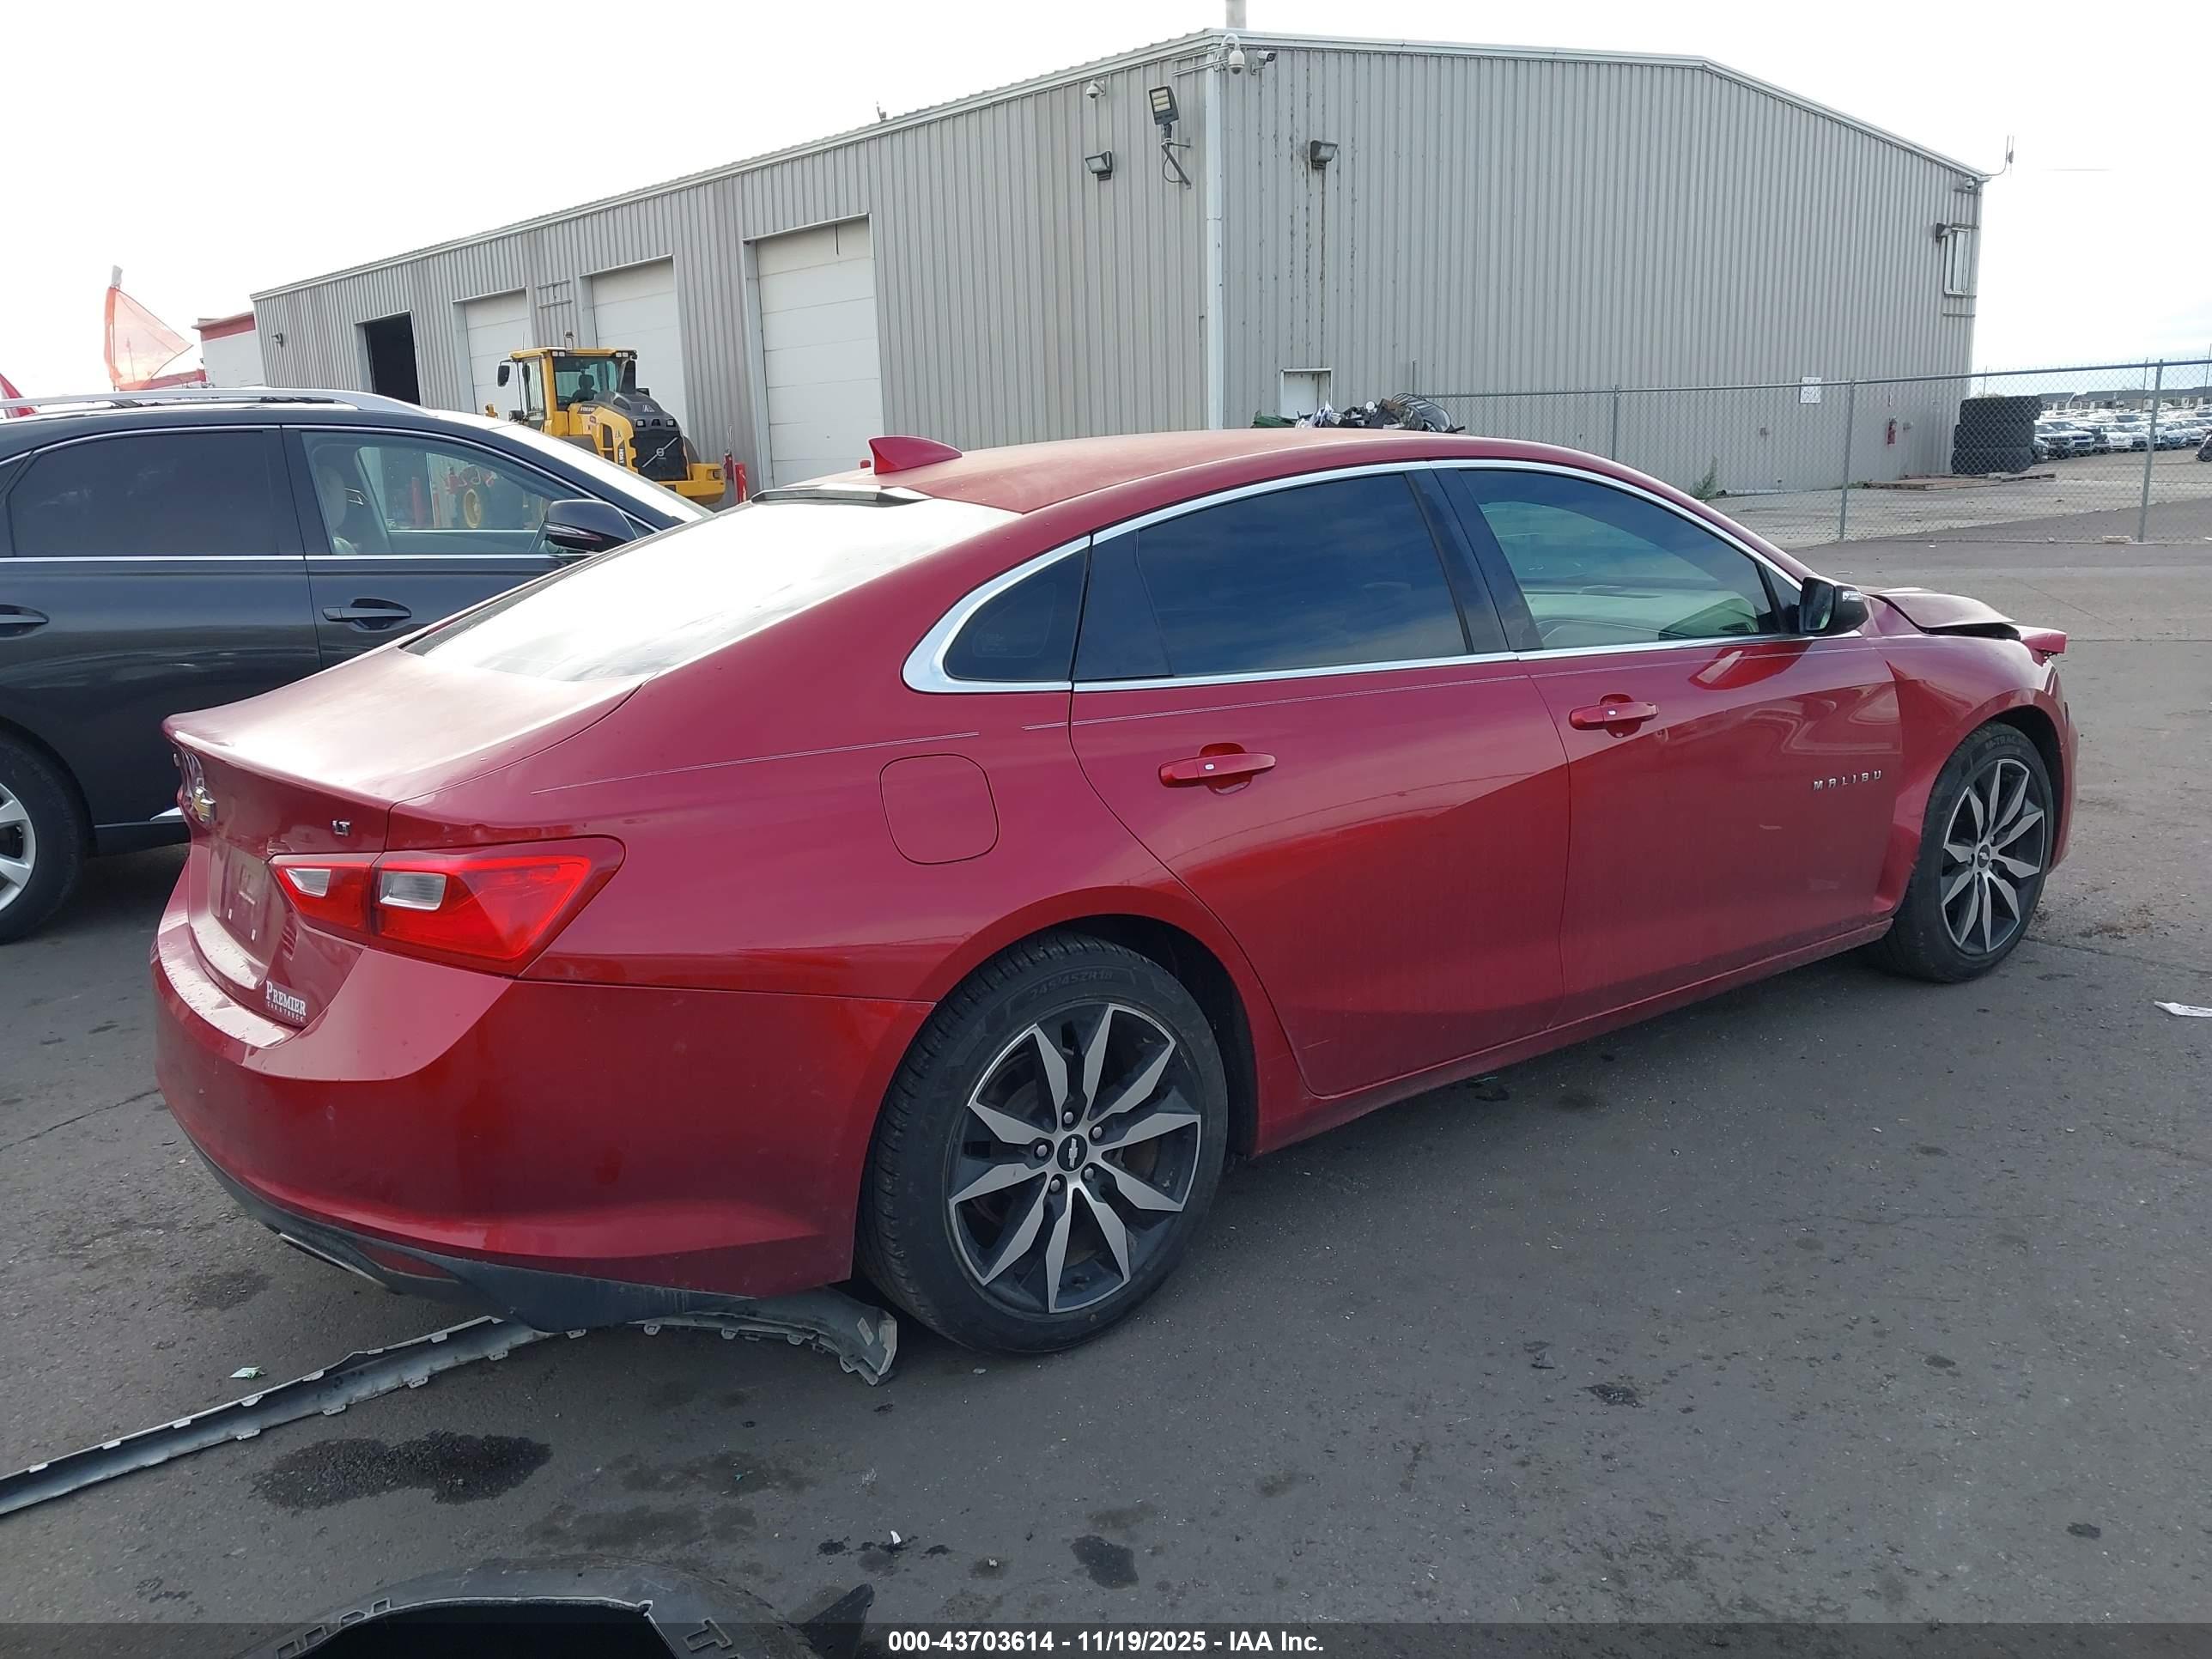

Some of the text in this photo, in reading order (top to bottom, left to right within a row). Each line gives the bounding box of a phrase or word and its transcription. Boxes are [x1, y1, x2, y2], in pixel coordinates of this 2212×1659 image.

[1814, 770, 1881, 790] MALIBU
[332, 820, 350, 836] LT
[265, 980, 307, 1016] PREMIER
